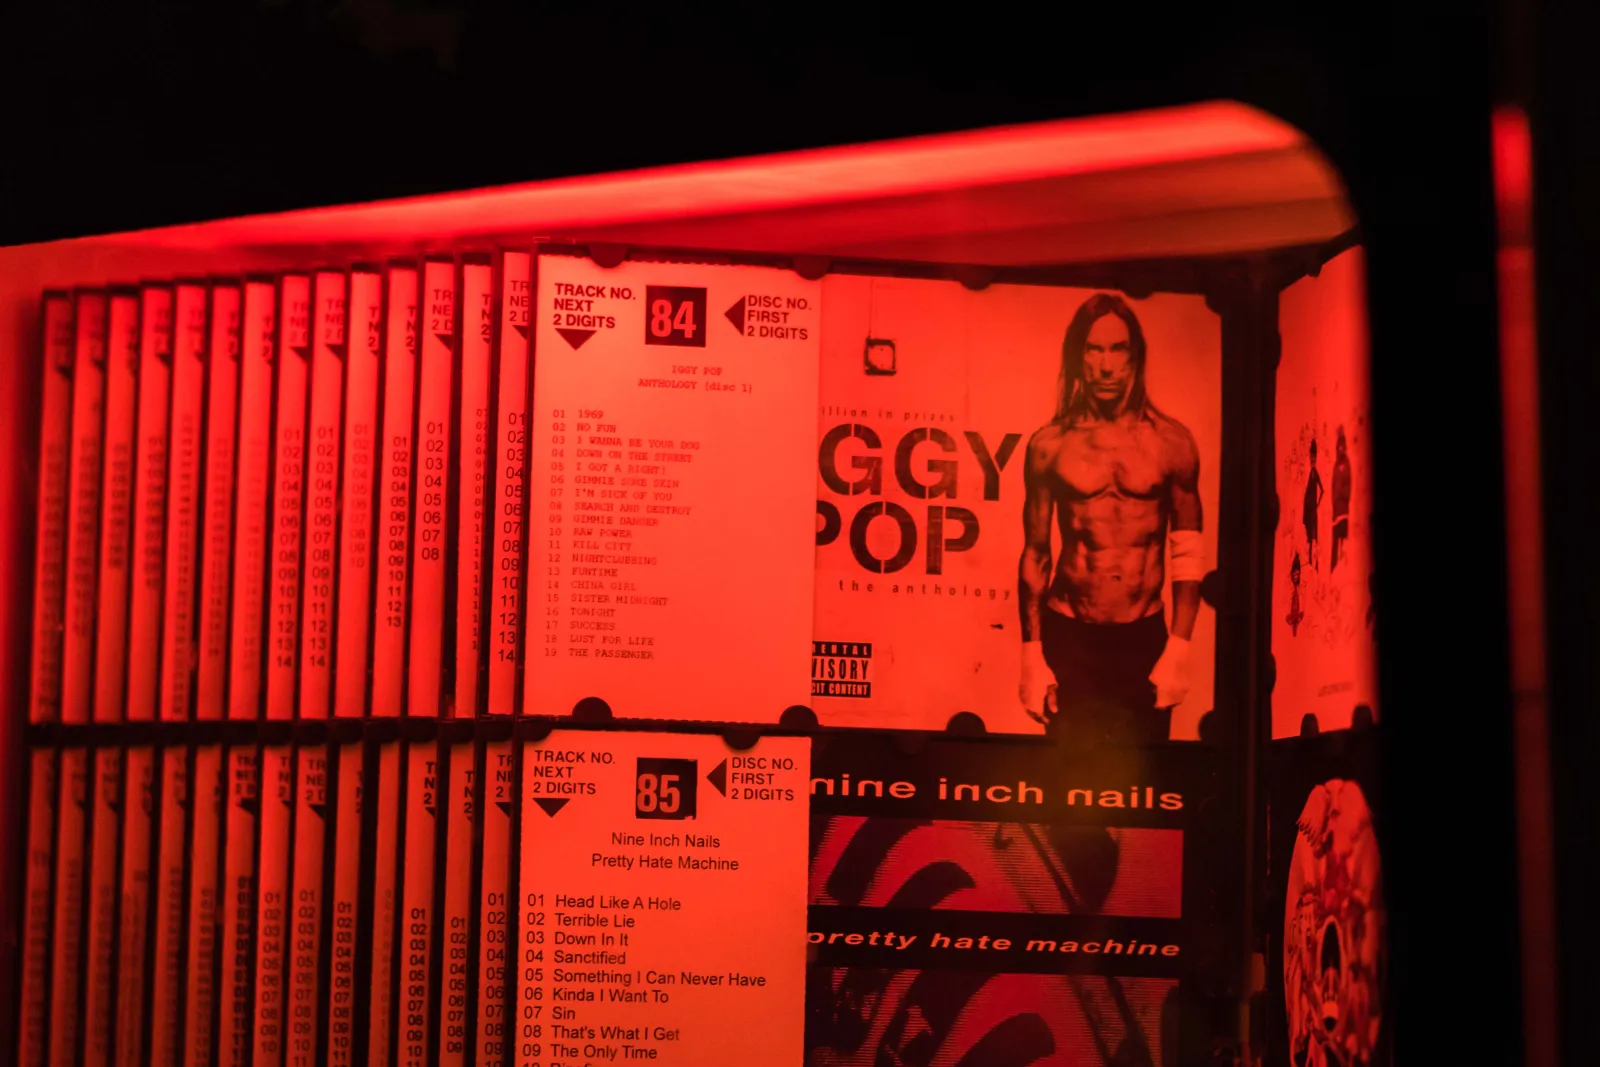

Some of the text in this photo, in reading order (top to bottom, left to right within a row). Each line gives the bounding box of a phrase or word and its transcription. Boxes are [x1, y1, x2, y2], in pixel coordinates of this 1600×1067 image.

[555, 283, 636, 300] TRACK NO.
[554, 298, 594, 312] NEXT
[748, 295, 812, 310] DISC NO.
[553, 314, 615, 328] 2 DIGITS
[651, 300, 696, 338] 84
[748, 311, 789, 323] FIRST
[748, 326, 808, 340] 2 DIGITS
[672, 366, 722, 376] IGGY POP
[639, 379, 697, 390] ANTHOLOGY
[553, 410, 565, 418] 01
[426, 422, 443, 434] 01
[553, 423, 616, 433] 02 NO FUN
[426, 440, 443, 452] 02
[552, 436, 564, 444] 03
[590, 437, 622, 446] WANNA
[649, 439, 673, 448] YOUR
[577, 450, 602, 458] DOWN
[609, 451, 621, 459] ON
[629, 452, 647, 460] THE
[426, 458, 443, 470] 03
[551, 462, 563, 470] 05
[589, 463, 608, 471] GOT
[425, 476, 442, 487] 04
[575, 476, 614, 485] GIMMIE
[653, 479, 678, 488] SKIN
[424, 494, 441, 506] 05
[551, 489, 563, 497] 07
[575, 489, 594, 497] I'M
[601, 490, 627, 499] SICK
[653, 492, 672, 501] YOU
[574, 502, 613, 512] SEARCH
[620, 504, 639, 512] AND
[423, 512, 440, 524] 06
[550, 515, 612, 524] 09 GIMMIE
[423, 529, 440, 542] 07
[550, 528, 632, 538] 10 RAW POWER
[549, 541, 632, 551] 11 KILL CITY
[422, 548, 439, 560] 08
[548, 554, 657, 565] 12 NIGHTCLUBBING
[548, 567, 618, 577] 13 FUNTIME
[571, 581, 604, 589] CHINA
[610, 582, 637, 591] GIRL
[839, 580, 1010, 599] the anthology
[547, 594, 559, 602] 15
[571, 594, 610, 603] SISTER
[571, 608, 615, 617] TONIGHT
[546, 621, 615, 630] 17 SUCCESS
[570, 635, 595, 643] LUST
[602, 636, 621, 644] FOR
[628, 637, 654, 645] LIFE
[545, 648, 654, 660] 19 THE PASSENGER
[535, 750, 615, 764] TRACK NO.
[732, 757, 798, 770] DISC NO.
[534, 766, 574, 778] NEXT
[732, 773, 774, 785] FIRST
[534, 782, 596, 794] 2 DIGITS
[637, 774, 680, 812] 85
[810, 774, 1184, 810] nine inch nails
[731, 789, 794, 801] 2 DIGITS
[612, 833, 720, 847] Nine Inch Nails
[592, 854, 738, 870] Pretty Hate Machine
[527, 894, 681, 910] 01 Head Like A Hole
[527, 914, 635, 928] 02 Terrible Lie
[527, 932, 628, 946] 03 Down In It
[807, 932, 1180, 957] pretty hate machine
[526, 951, 626, 964] 04 Sanctified
[525, 969, 766, 986] 05 Something I Can Never Have
[525, 988, 668, 1003] 06 Kinda I Want To
[524, 1007, 575, 1020] 07 Sin
[523, 1026, 680, 1041] 08 That's What I Get
[523, 1045, 657, 1061] 09 The Only Time
